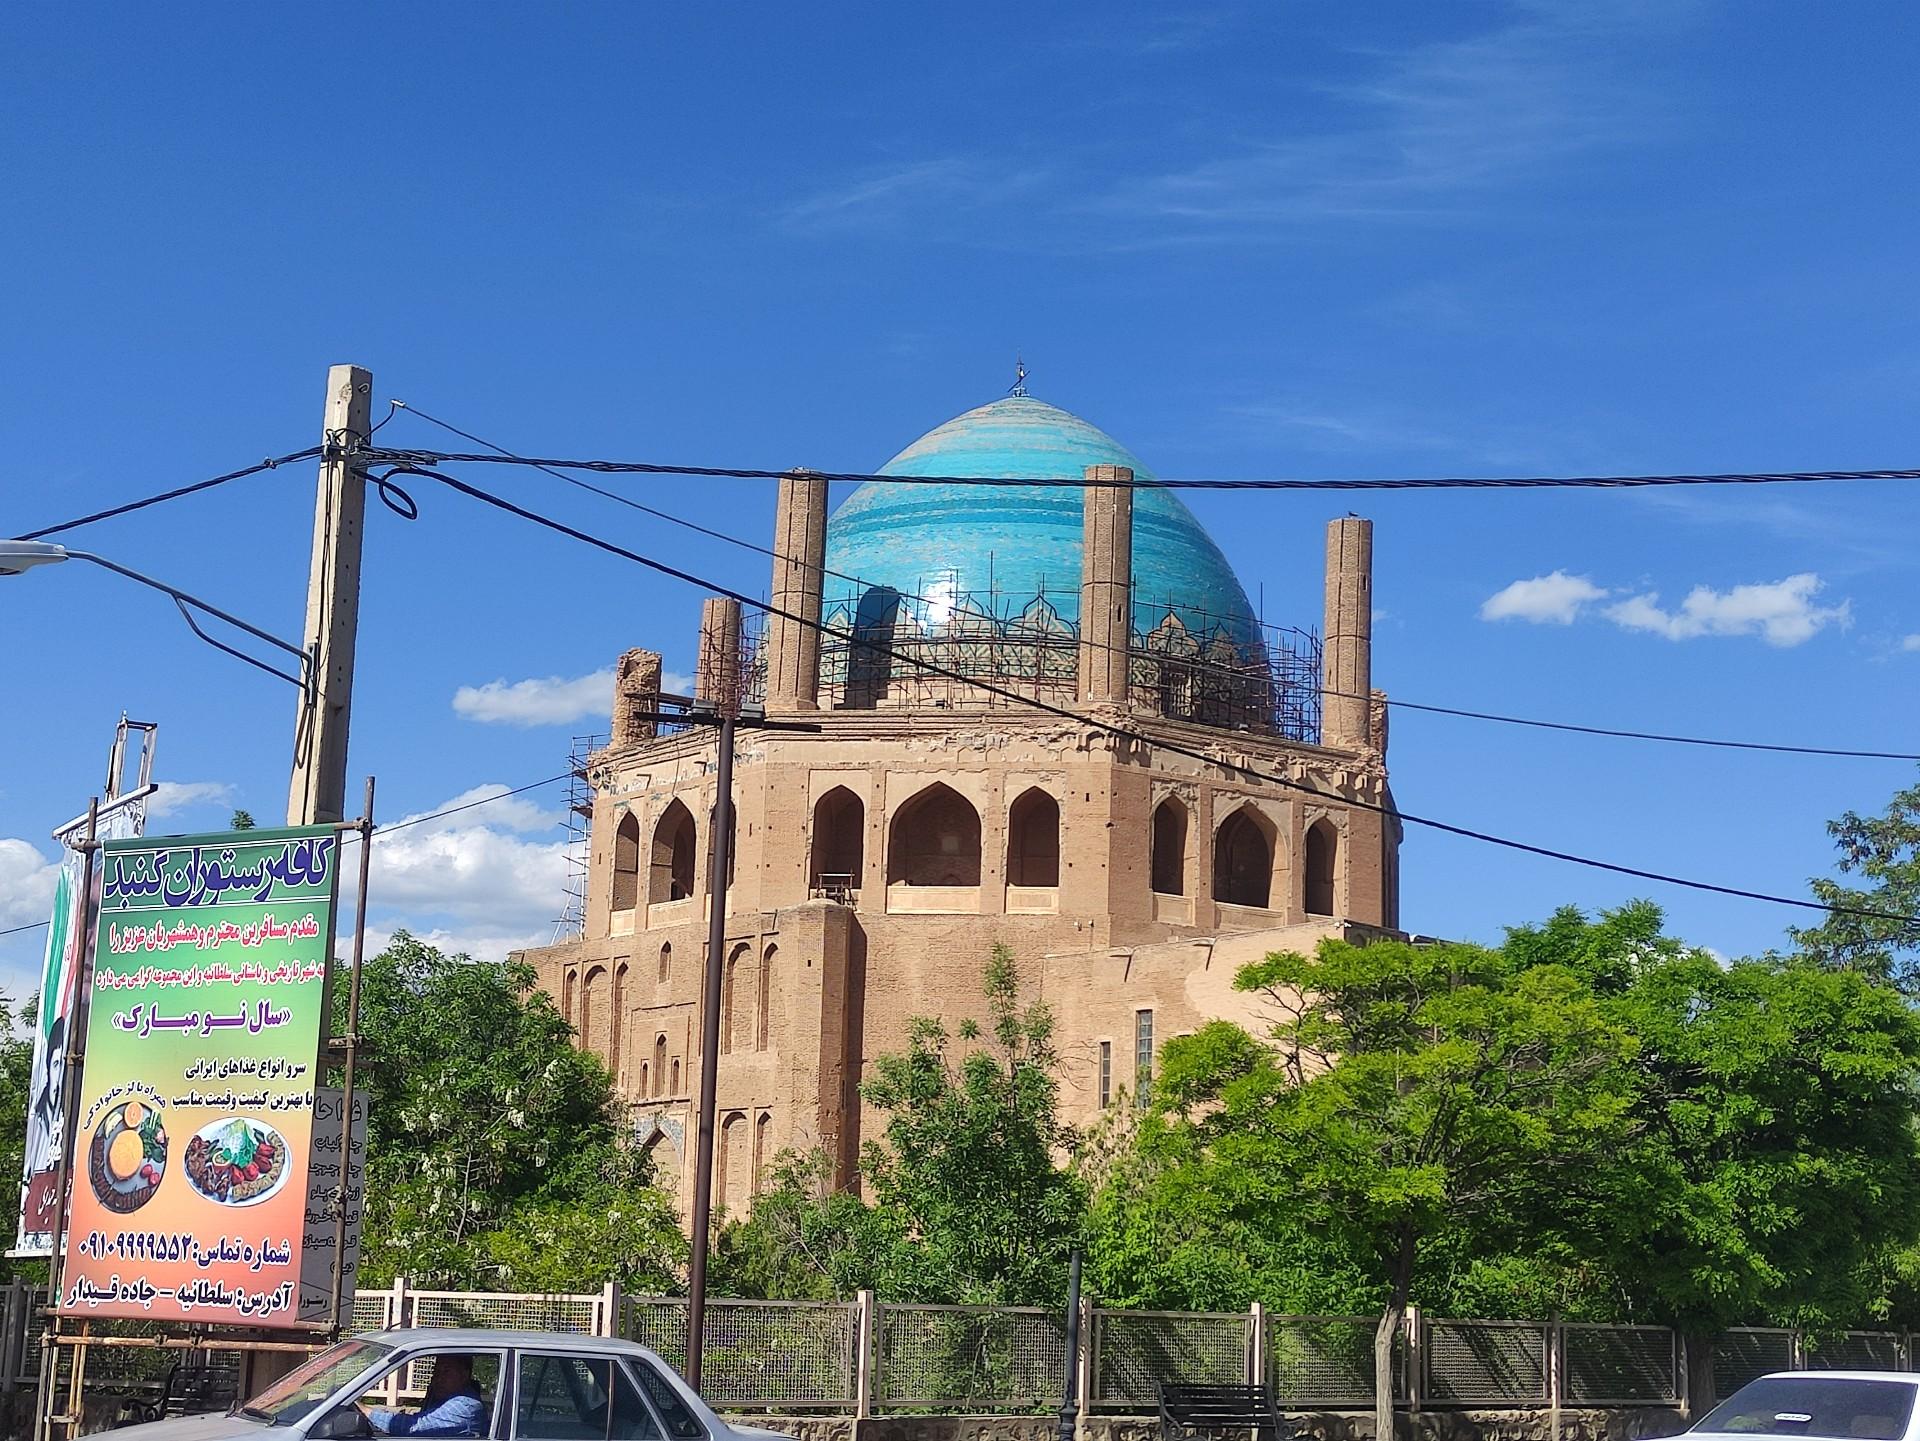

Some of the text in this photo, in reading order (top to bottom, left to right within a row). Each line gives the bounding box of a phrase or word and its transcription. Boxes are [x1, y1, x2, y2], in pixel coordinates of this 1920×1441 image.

[163, 848, 276, 906] رستوران
[109, 922, 121, 953] را
[120, 926, 146, 952] عزیز
[204, 921, 241, 949] محترم
[242, 914, 288, 947] مسافرین
[288, 914, 319, 945] مقدم
[298, 960, 316, 984] شهر
[185, 1058, 217, 1080] ایرانی
[218, 1058, 257, 1079] غذاهای
[257, 1058, 285, 1079] انواع
[171, 1090, 204, 1110] مناسب
[238, 1090, 270, 1110] کیفیت
[269, 1091, 304, 1111] بهترین
[304, 1090, 314, 1110] با
[242, 1239, 291, 1271] شماره
[65, 1274, 119, 1308] قیدار
[120, 1277, 157, 1309] جاده
[177, 1279, 234, 1311] سلطانیه
